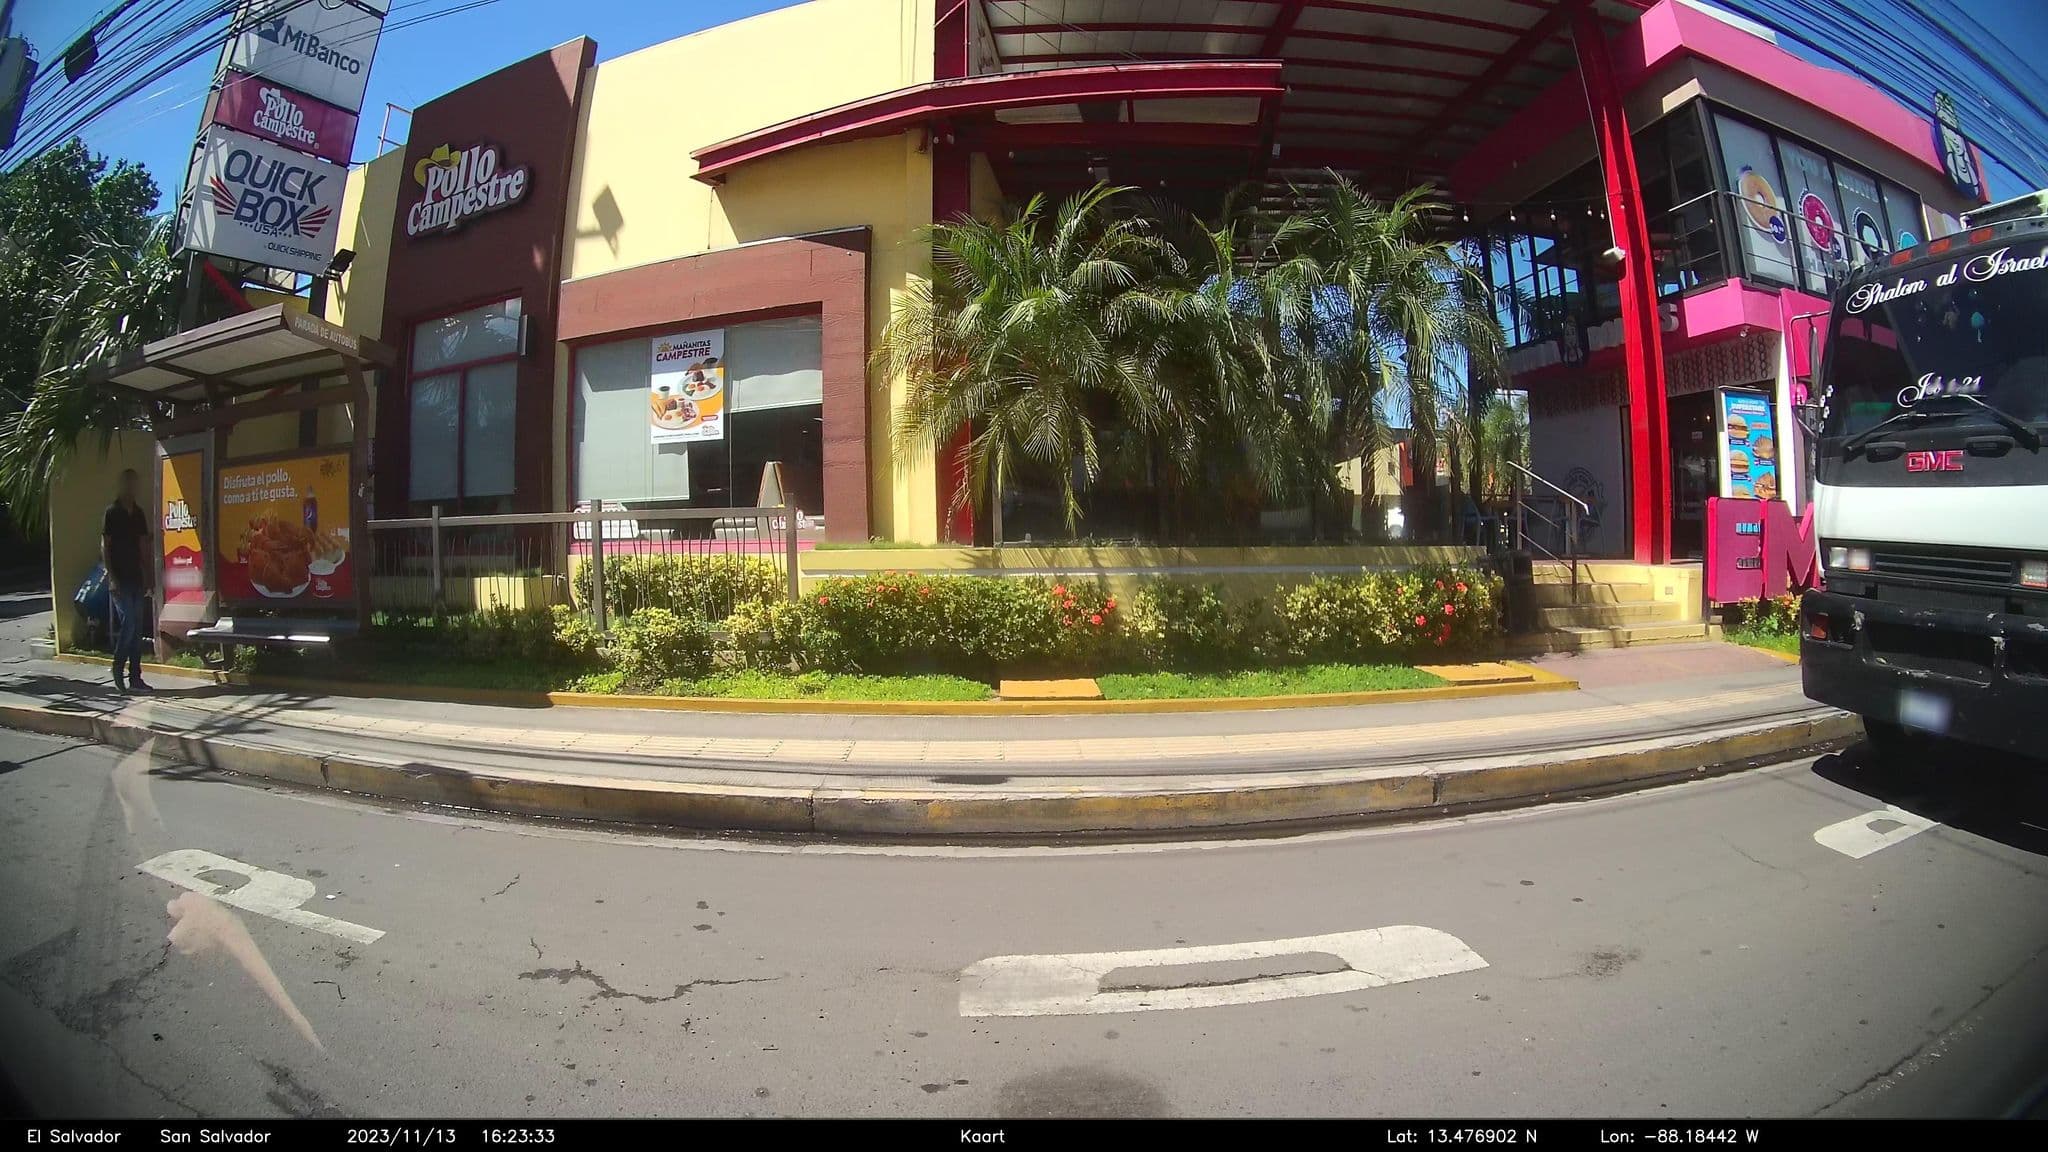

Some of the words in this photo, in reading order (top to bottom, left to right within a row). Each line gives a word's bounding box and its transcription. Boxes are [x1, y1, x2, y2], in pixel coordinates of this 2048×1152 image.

[264, 95, 304, 126] Pollo
[253, 110, 316, 145] Campestre
[224, 149, 327, 205] QUICK
[423, 145, 496, 207] Pollo
[233, 188, 308, 236] BOX
[407, 169, 525, 236] Campestre
[253, 222, 278, 237] USA
[1846, 278, 1928, 314] Shalom
[1936, 263, 1958, 288] al
[656, 347, 711, 362] CAMPESTRE
[672, 340, 711, 351] MAÑANITAS
[1906, 449, 1964, 472] GMC
[223, 474, 256, 489] Disfruta
[257, 470, 265, 485] el
[266, 467, 291, 488] pollo,
[223, 492, 245, 504] como
[260, 488, 269, 502] te
[269, 485, 298, 502] gusta.
[169, 500, 189, 518] Pollo
[165, 514, 197, 531] Campestre
